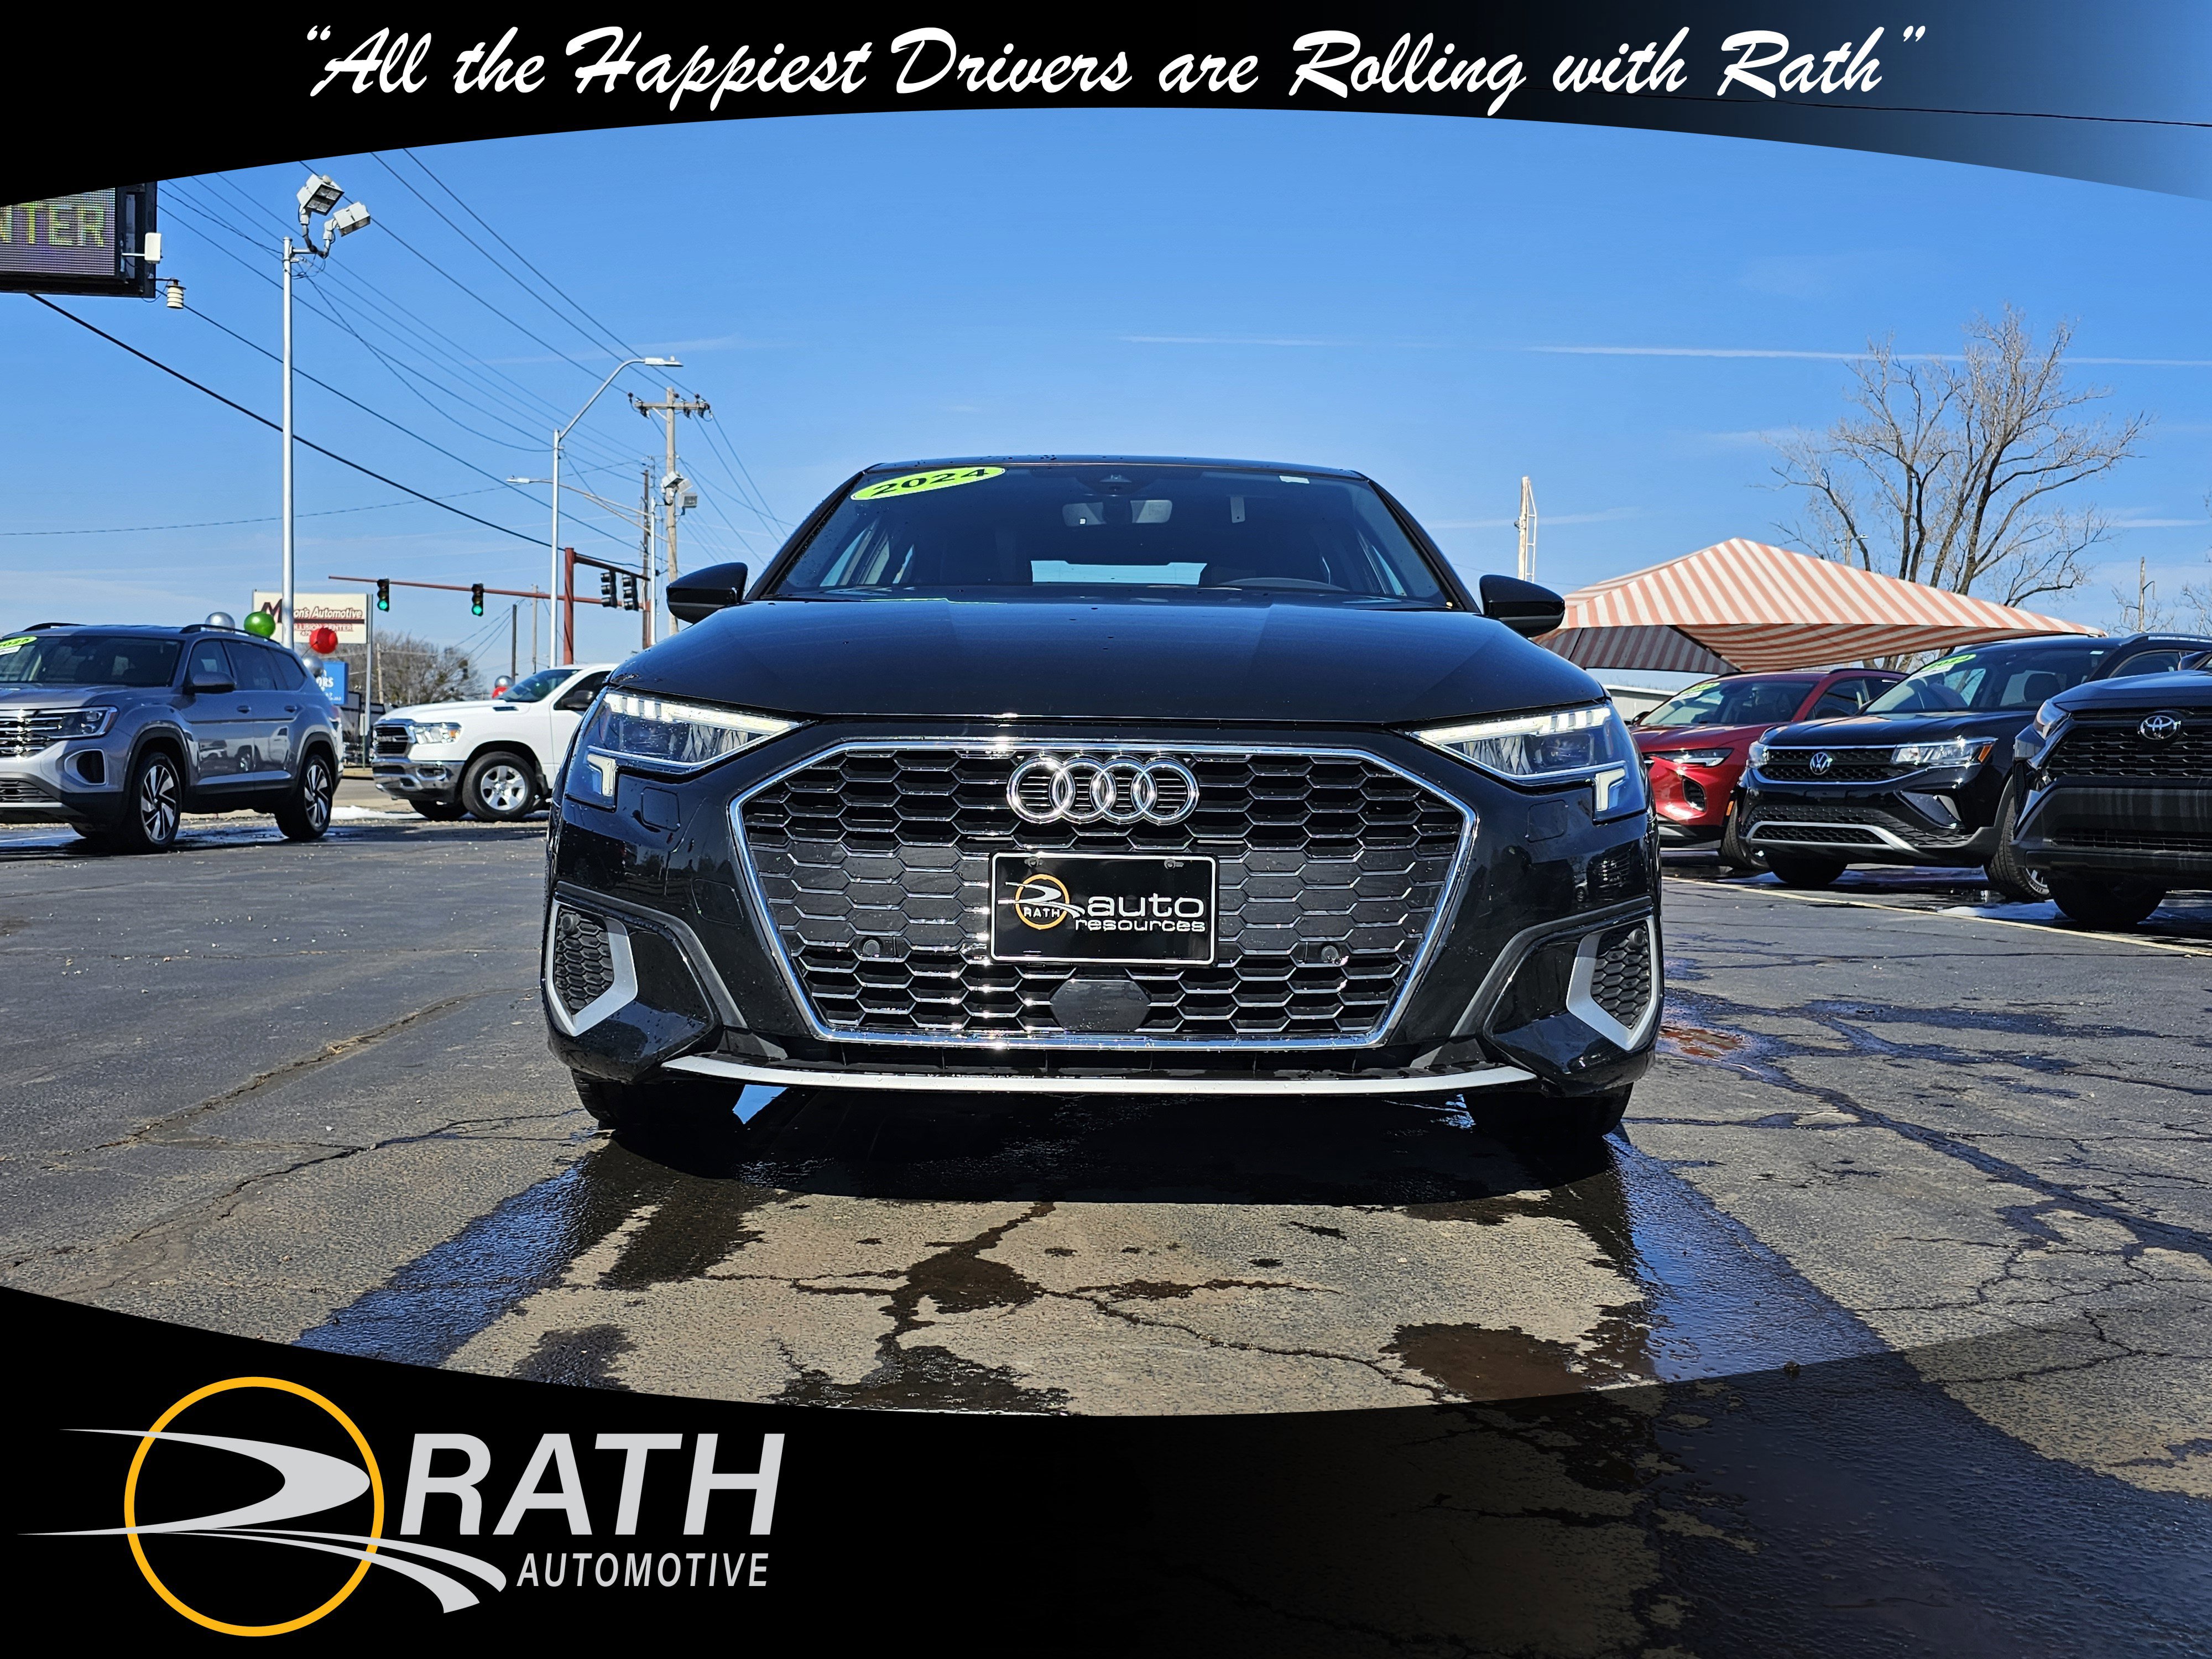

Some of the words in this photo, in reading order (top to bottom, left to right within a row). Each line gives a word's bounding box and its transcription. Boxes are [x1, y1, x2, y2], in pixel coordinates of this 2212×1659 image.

[870, 468, 989, 496] 2024
[311, 606, 363, 619] Automotive
[1087, 893, 1204, 918] auto
[1023, 907, 1061, 919] RATH
[1074, 918, 1206, 932] resources
